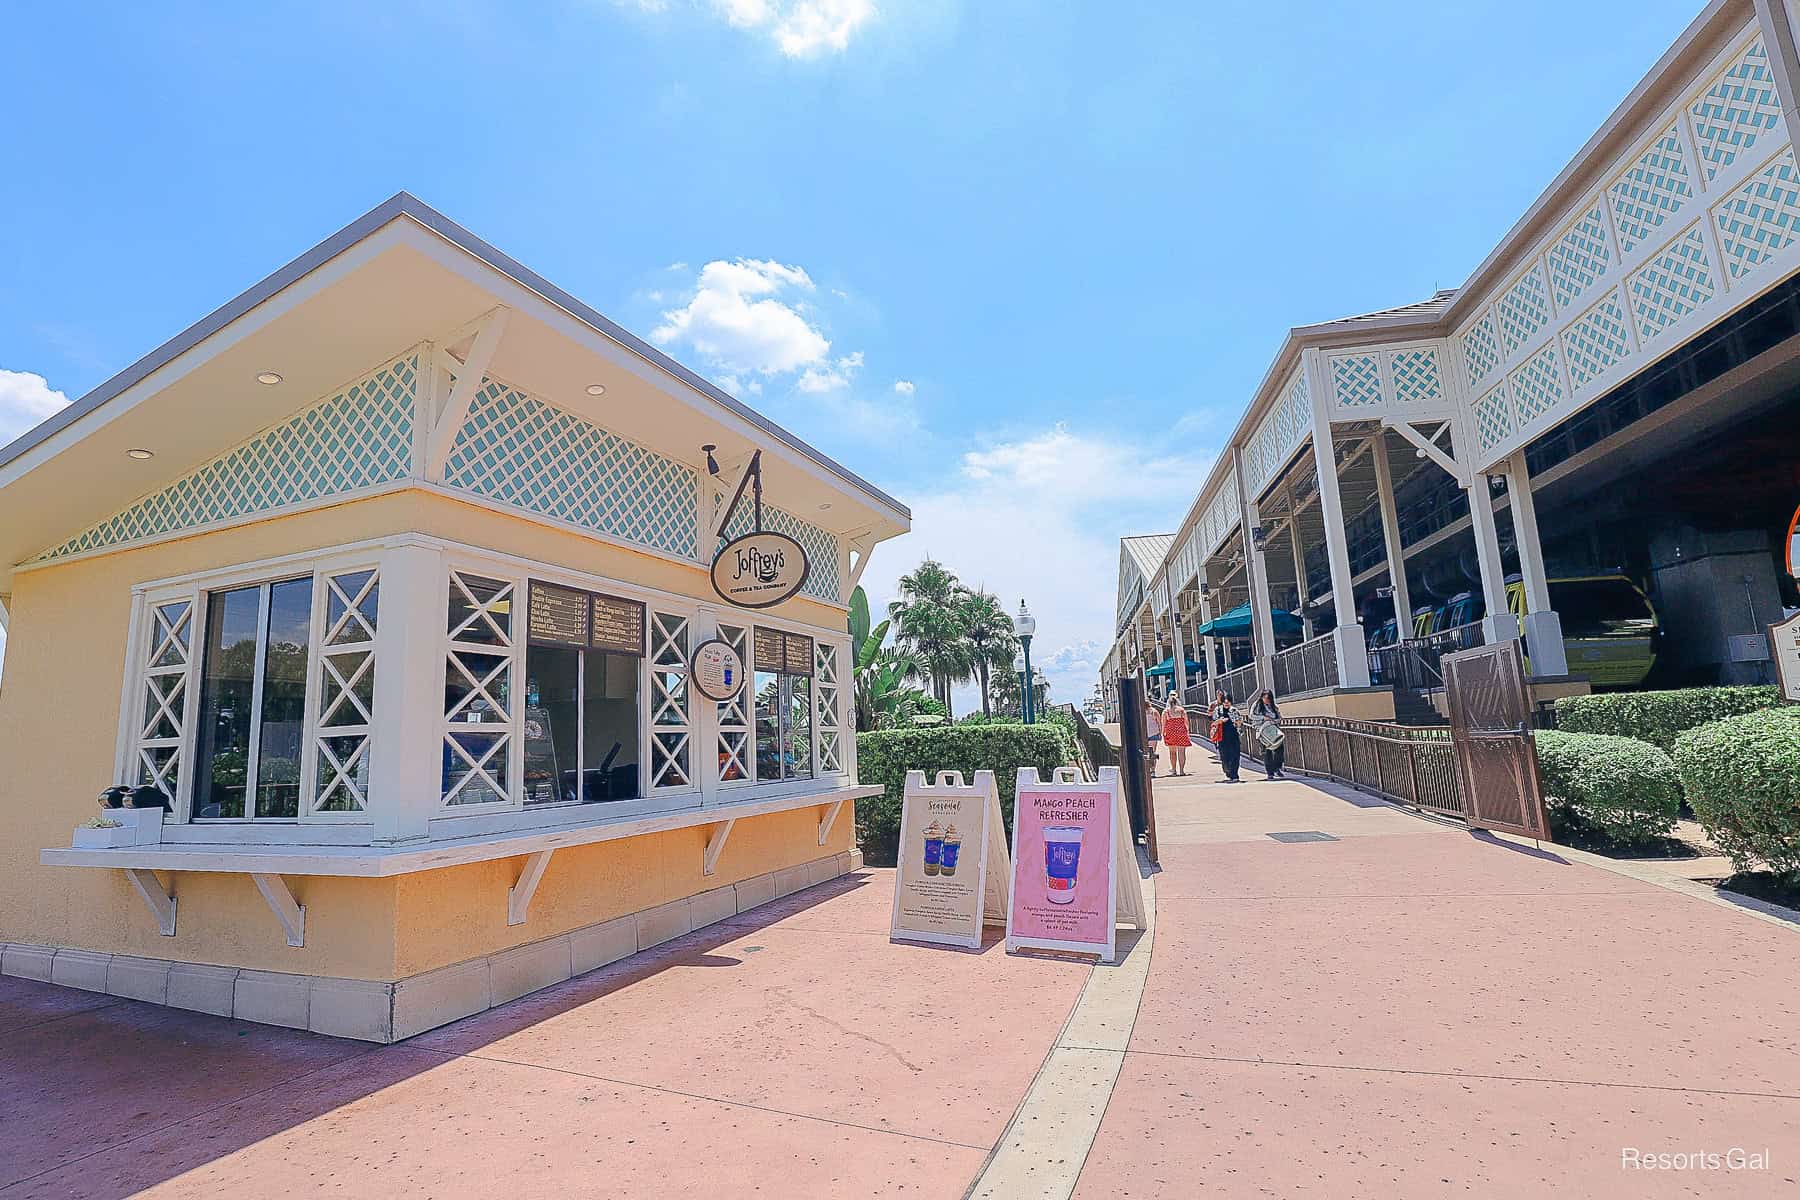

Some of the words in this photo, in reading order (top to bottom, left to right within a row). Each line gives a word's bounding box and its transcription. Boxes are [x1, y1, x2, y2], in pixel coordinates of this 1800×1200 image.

[733, 547, 785, 581] Joffrey's
[1791, 626, 1800, 634] S
[1033, 799, 1063, 808] MANGO
[1065, 798, 1095, 808] PEACH
[1039, 811, 1089, 820] REFRESHER
